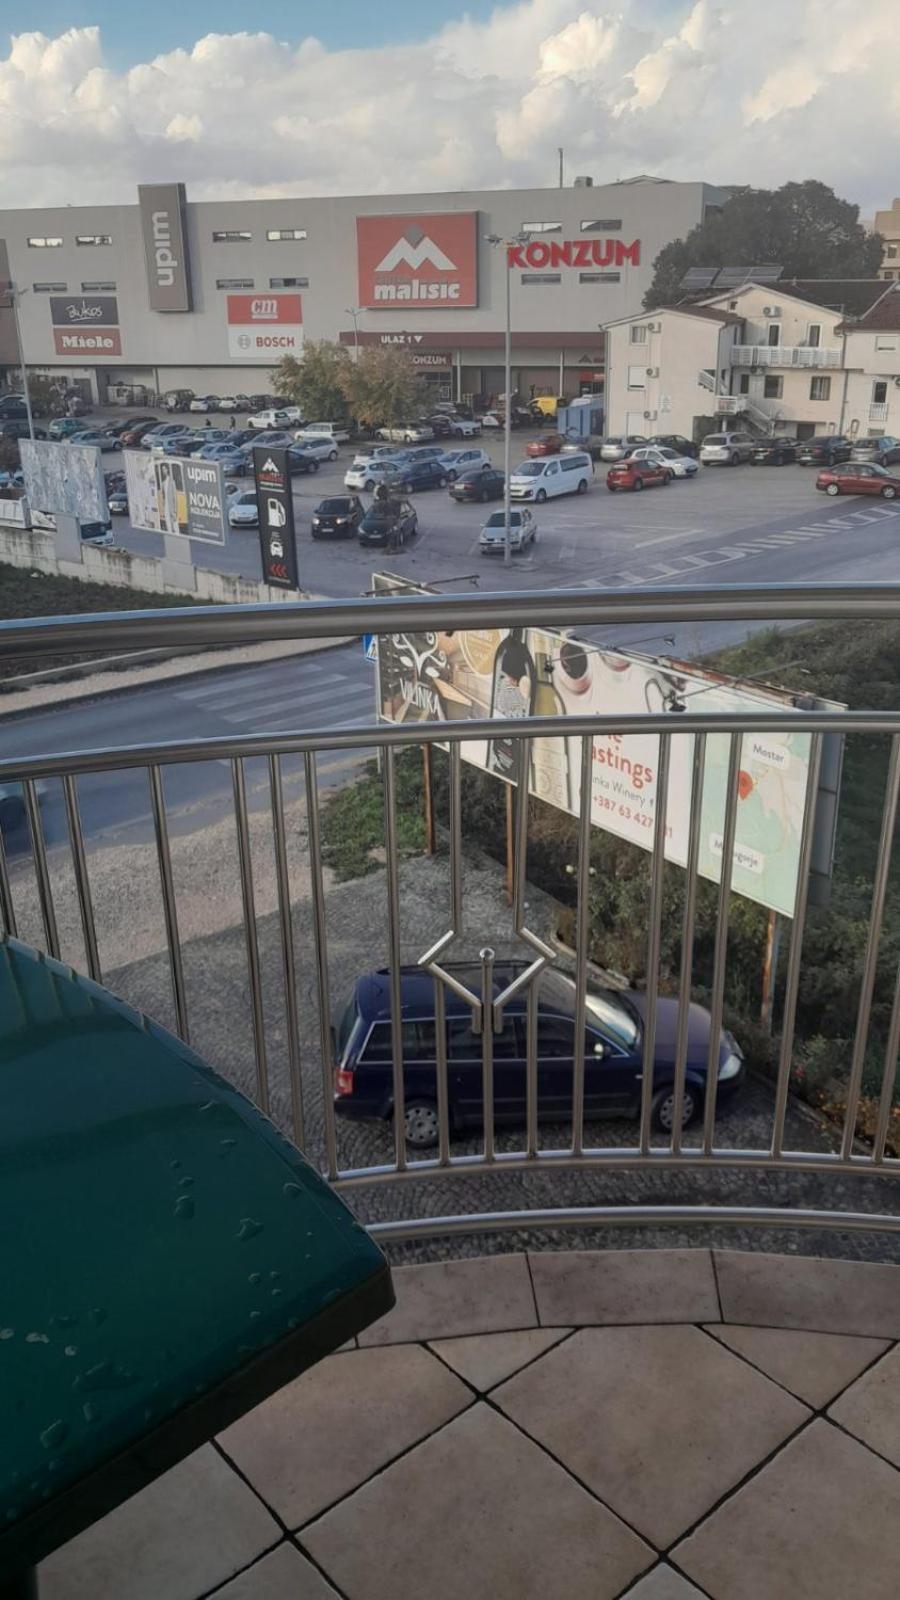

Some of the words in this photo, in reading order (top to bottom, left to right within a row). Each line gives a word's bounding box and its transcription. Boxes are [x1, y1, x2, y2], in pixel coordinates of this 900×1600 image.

[152, 211, 177, 286] upim
[507, 240, 641, 268] KONZUM
[62, 336, 113, 348] Miele
[256, 336, 295, 348] BOSCH
[381, 336, 406, 344] ULAZ
[407, 336, 412, 344] 1
[412, 356, 447, 365] ONZUM
[187, 467, 216, 484] upim
[189, 492, 220, 510] NOVA
[753, 744, 785, 763] Mostar
[591, 746, 653, 789] astings
[612, 781, 646, 808] Winery
[593, 795, 616, 811] +387
[618, 805, 631, 819] 63
[633, 813, 654, 828] 427
